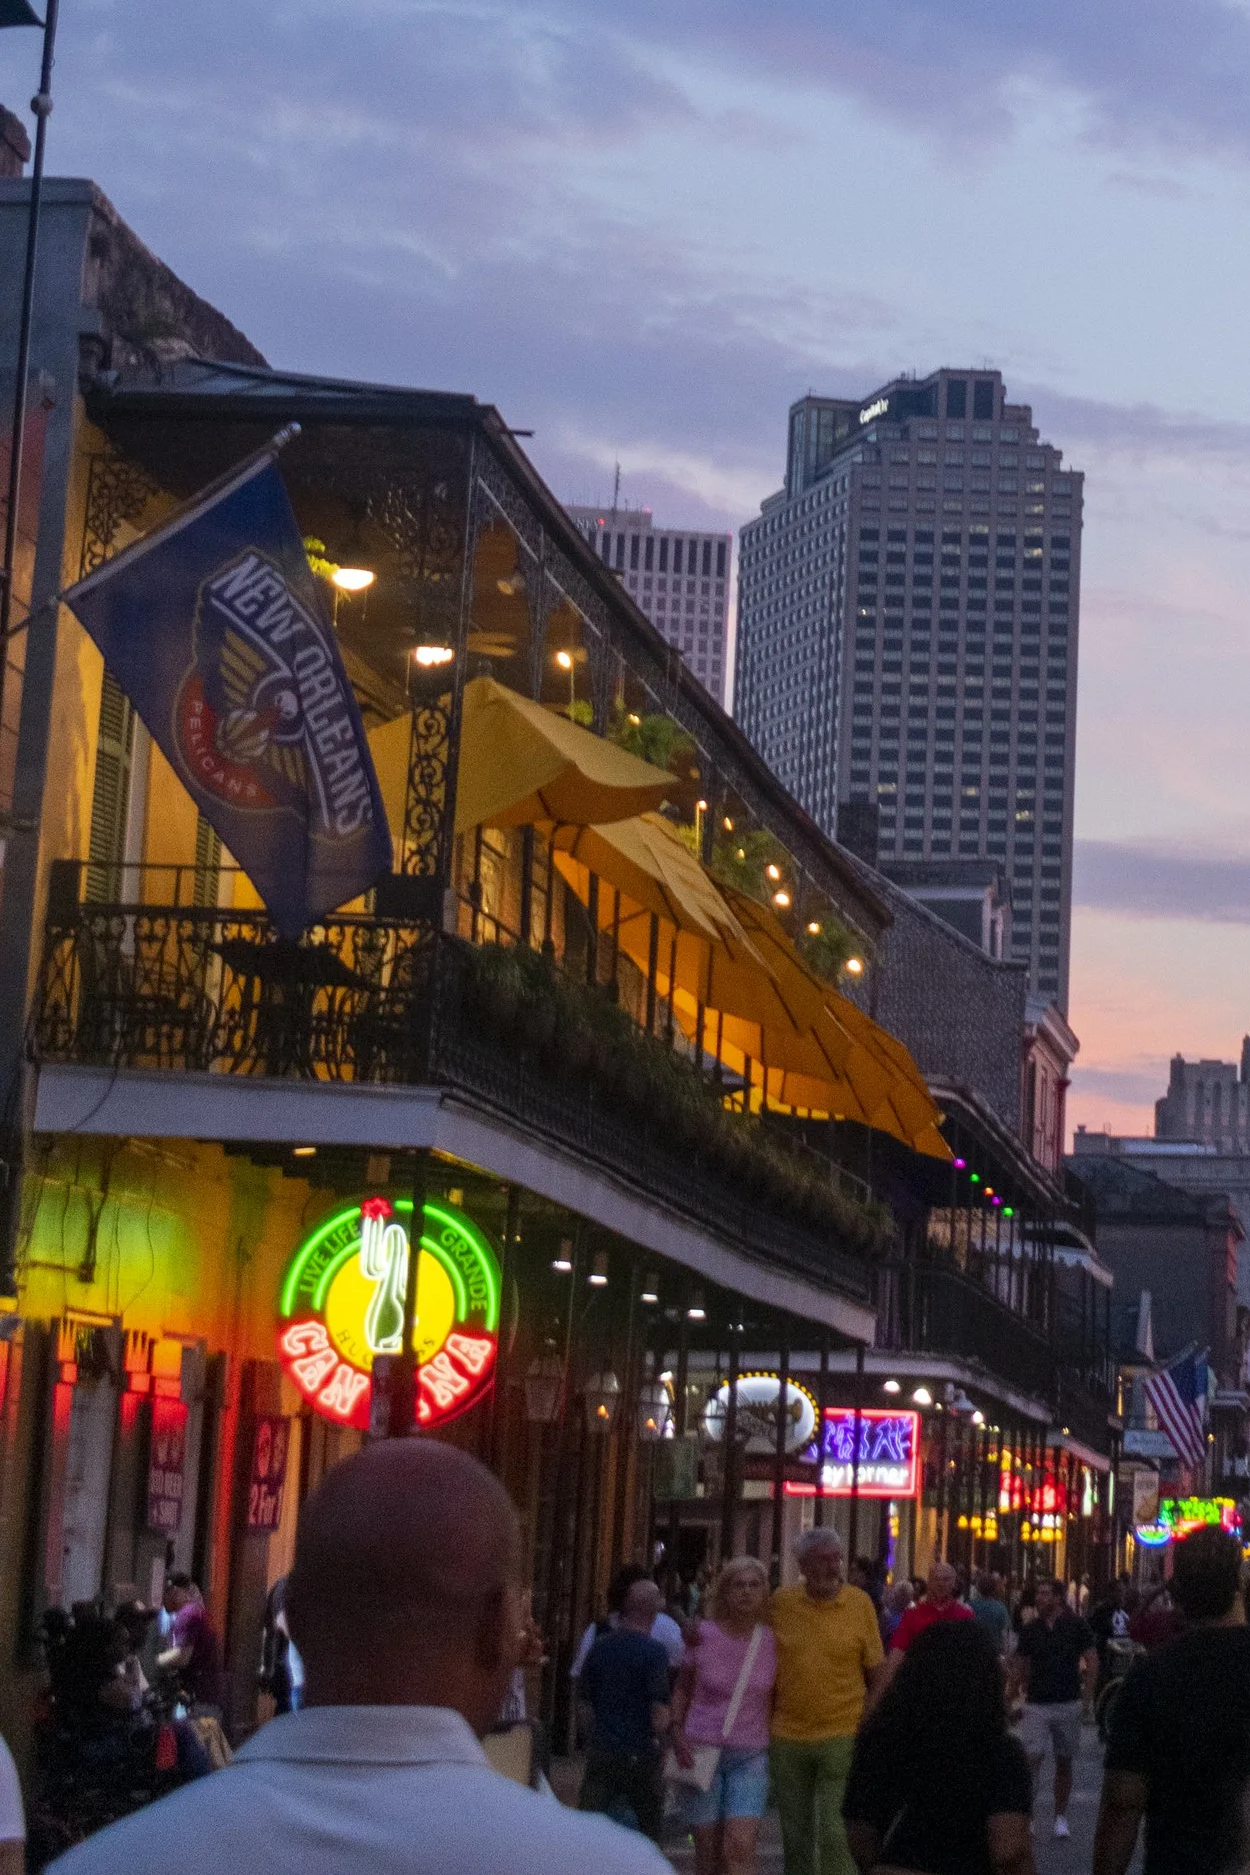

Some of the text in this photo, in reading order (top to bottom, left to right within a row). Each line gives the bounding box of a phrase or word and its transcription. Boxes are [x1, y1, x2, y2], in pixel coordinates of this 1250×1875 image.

[210, 555, 374, 835] NEW ORLEANS
[188, 701, 257, 798] PELICANS
[299, 1220, 487, 1311] LIVE LIFE GRANDE
[281, 1320, 493, 1418] CANNA
